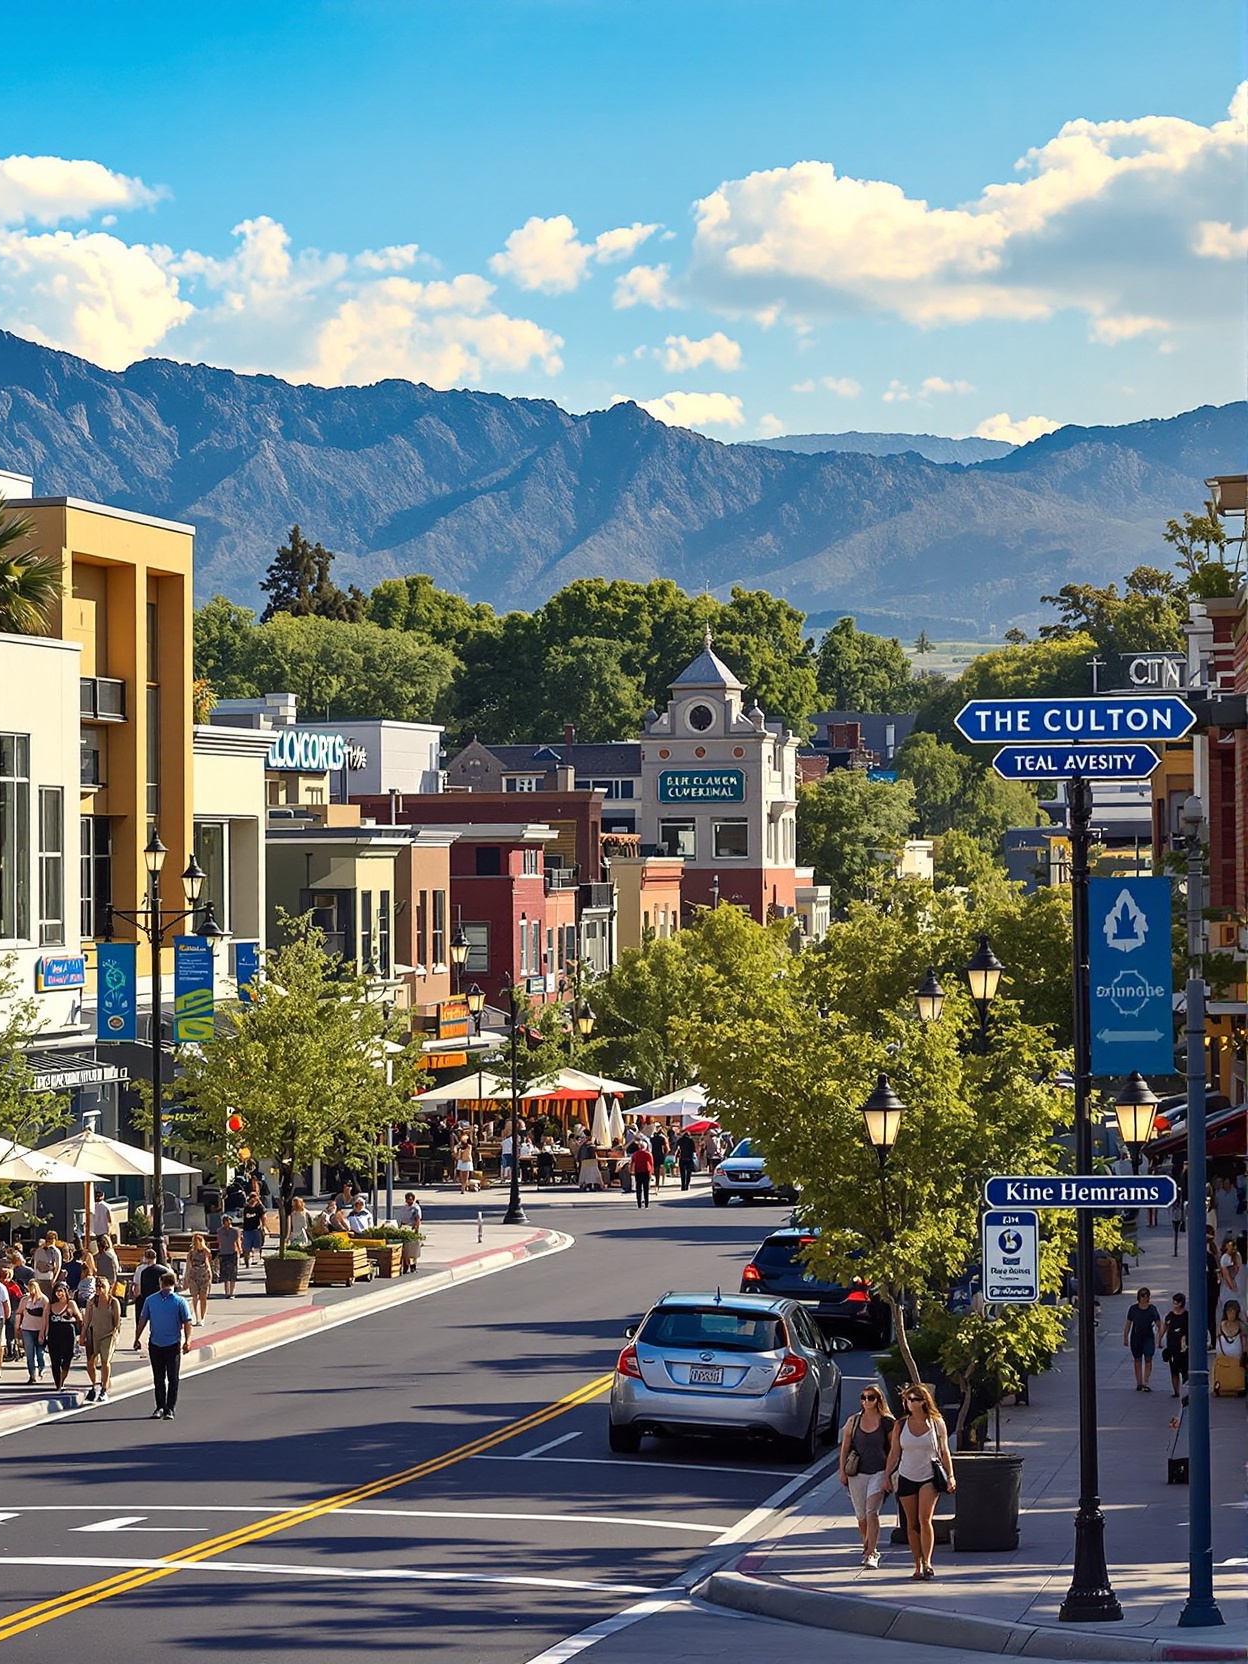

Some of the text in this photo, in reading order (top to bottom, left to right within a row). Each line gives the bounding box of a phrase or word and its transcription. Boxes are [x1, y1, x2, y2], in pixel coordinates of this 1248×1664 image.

[975, 707, 1172, 732] THE CULTON
[1014, 754, 1136, 771] TEAL AVESITY
[1006, 1182, 1054, 1201] Kine
